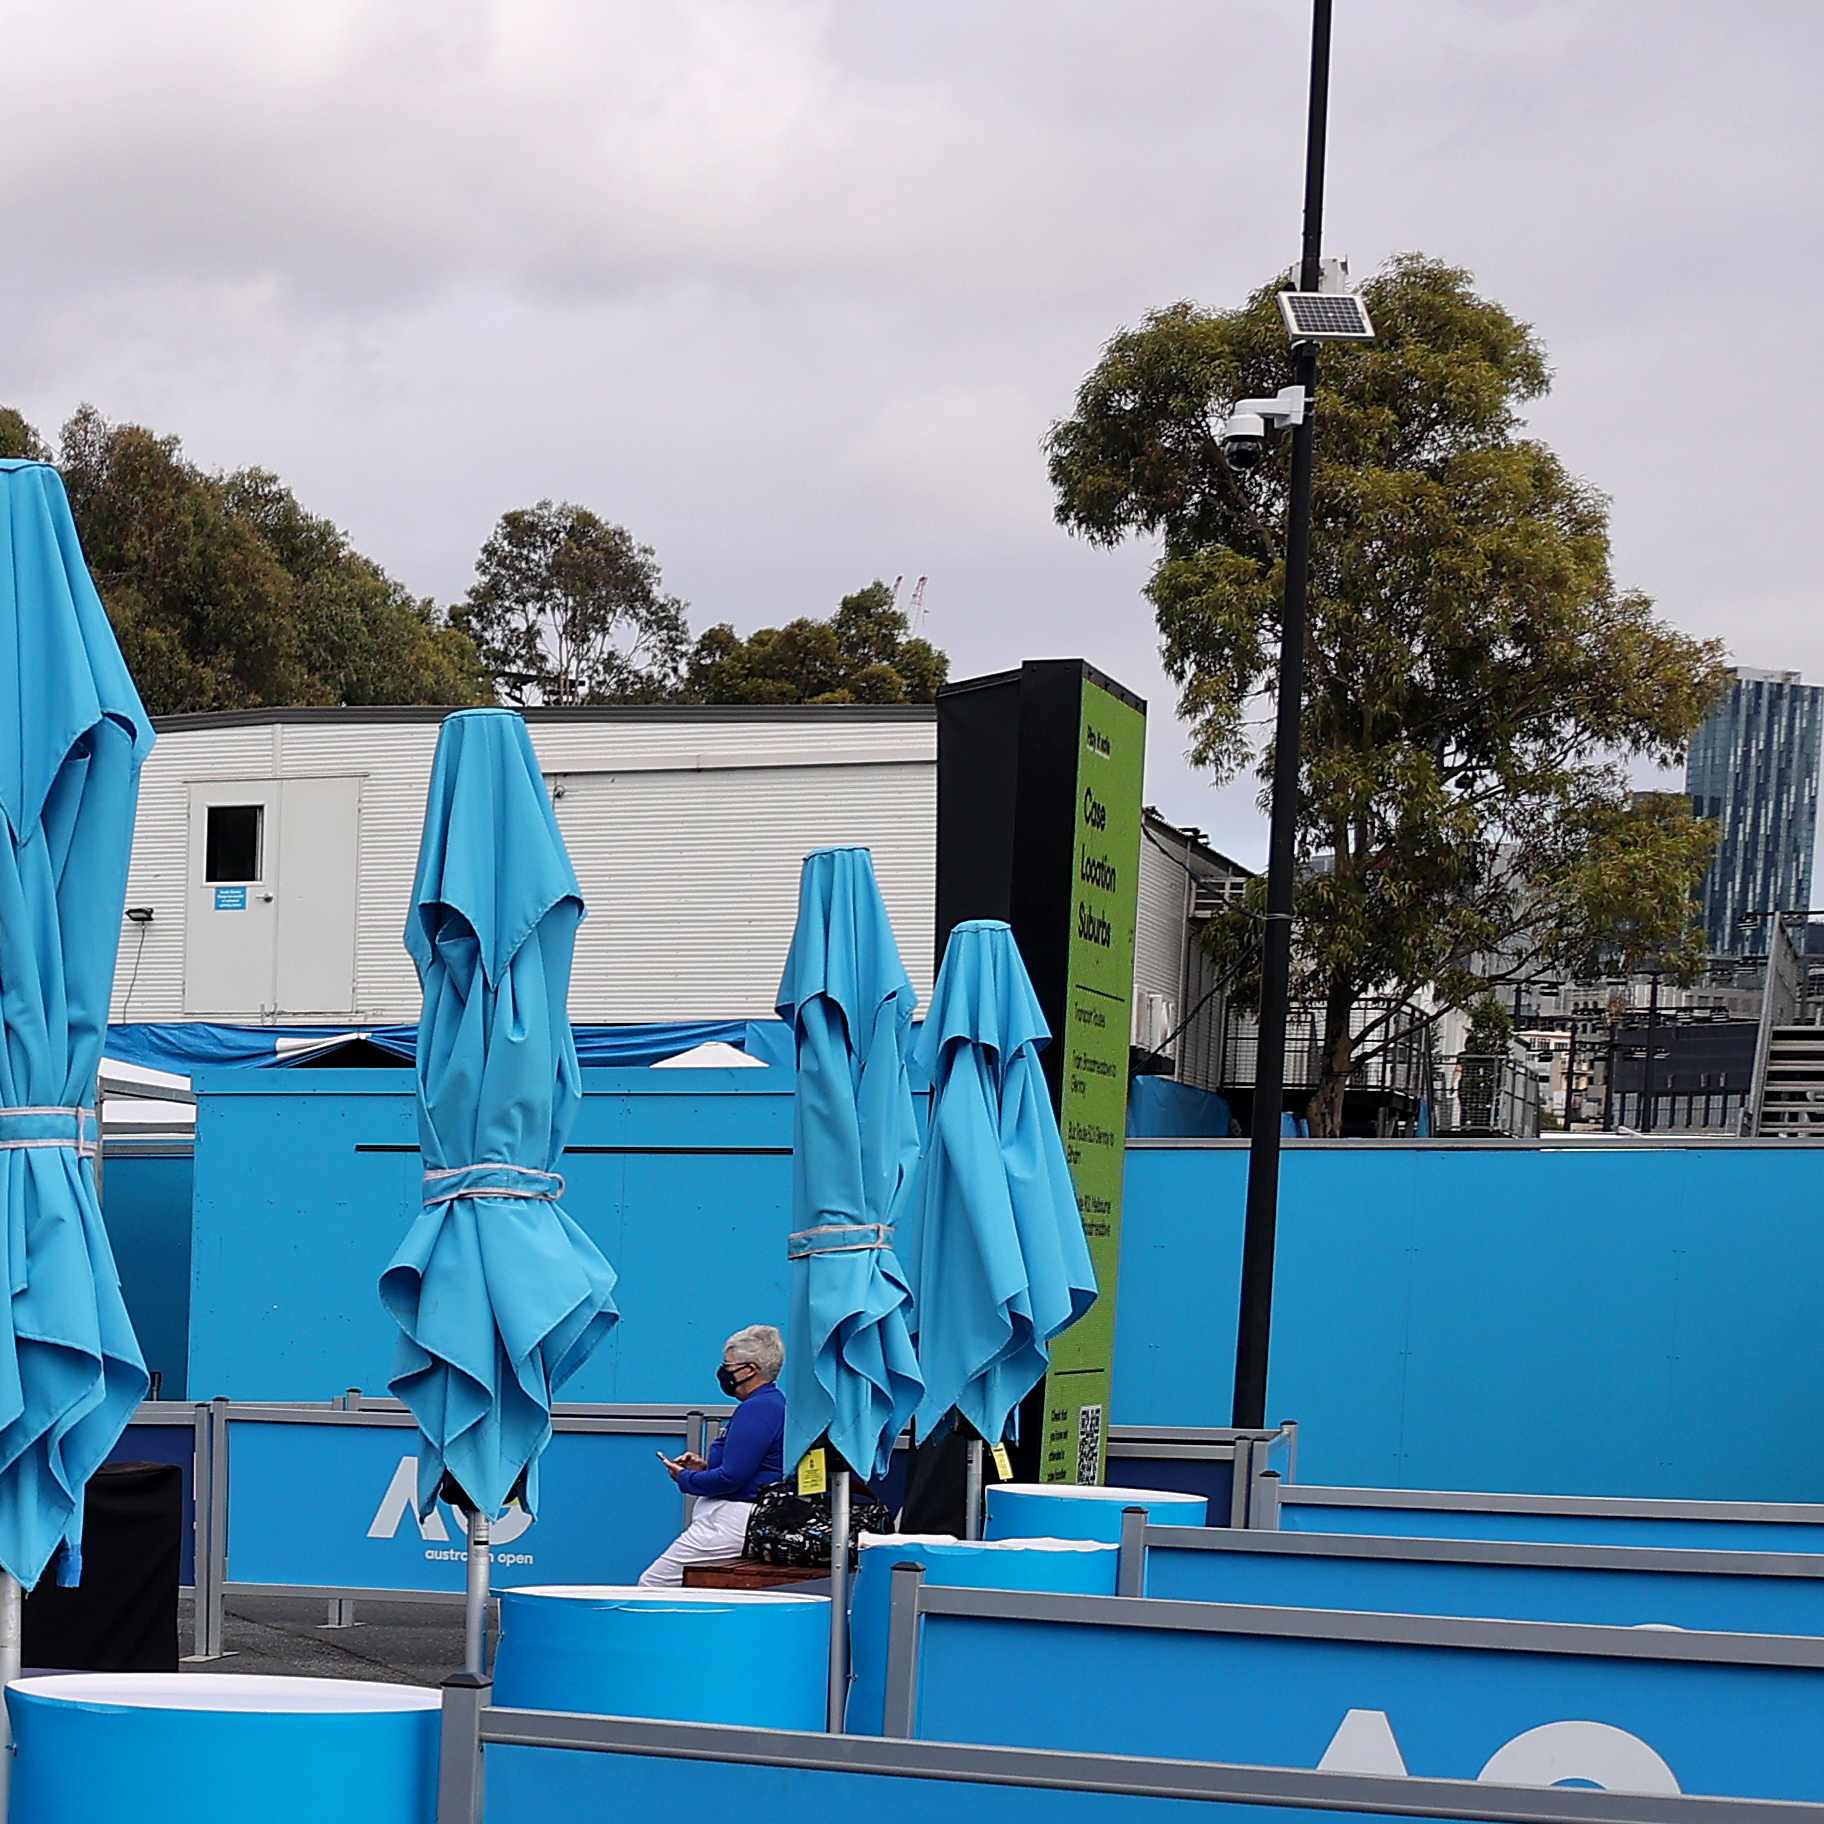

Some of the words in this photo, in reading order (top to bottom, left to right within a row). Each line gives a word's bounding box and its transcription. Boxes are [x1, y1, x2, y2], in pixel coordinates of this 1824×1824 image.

[1084, 786, 1106, 832] Case
[1080, 843, 1117, 893] Location
[1078, 901, 1111, 949] Suburbs
[497, 1552, 534, 1567] open
